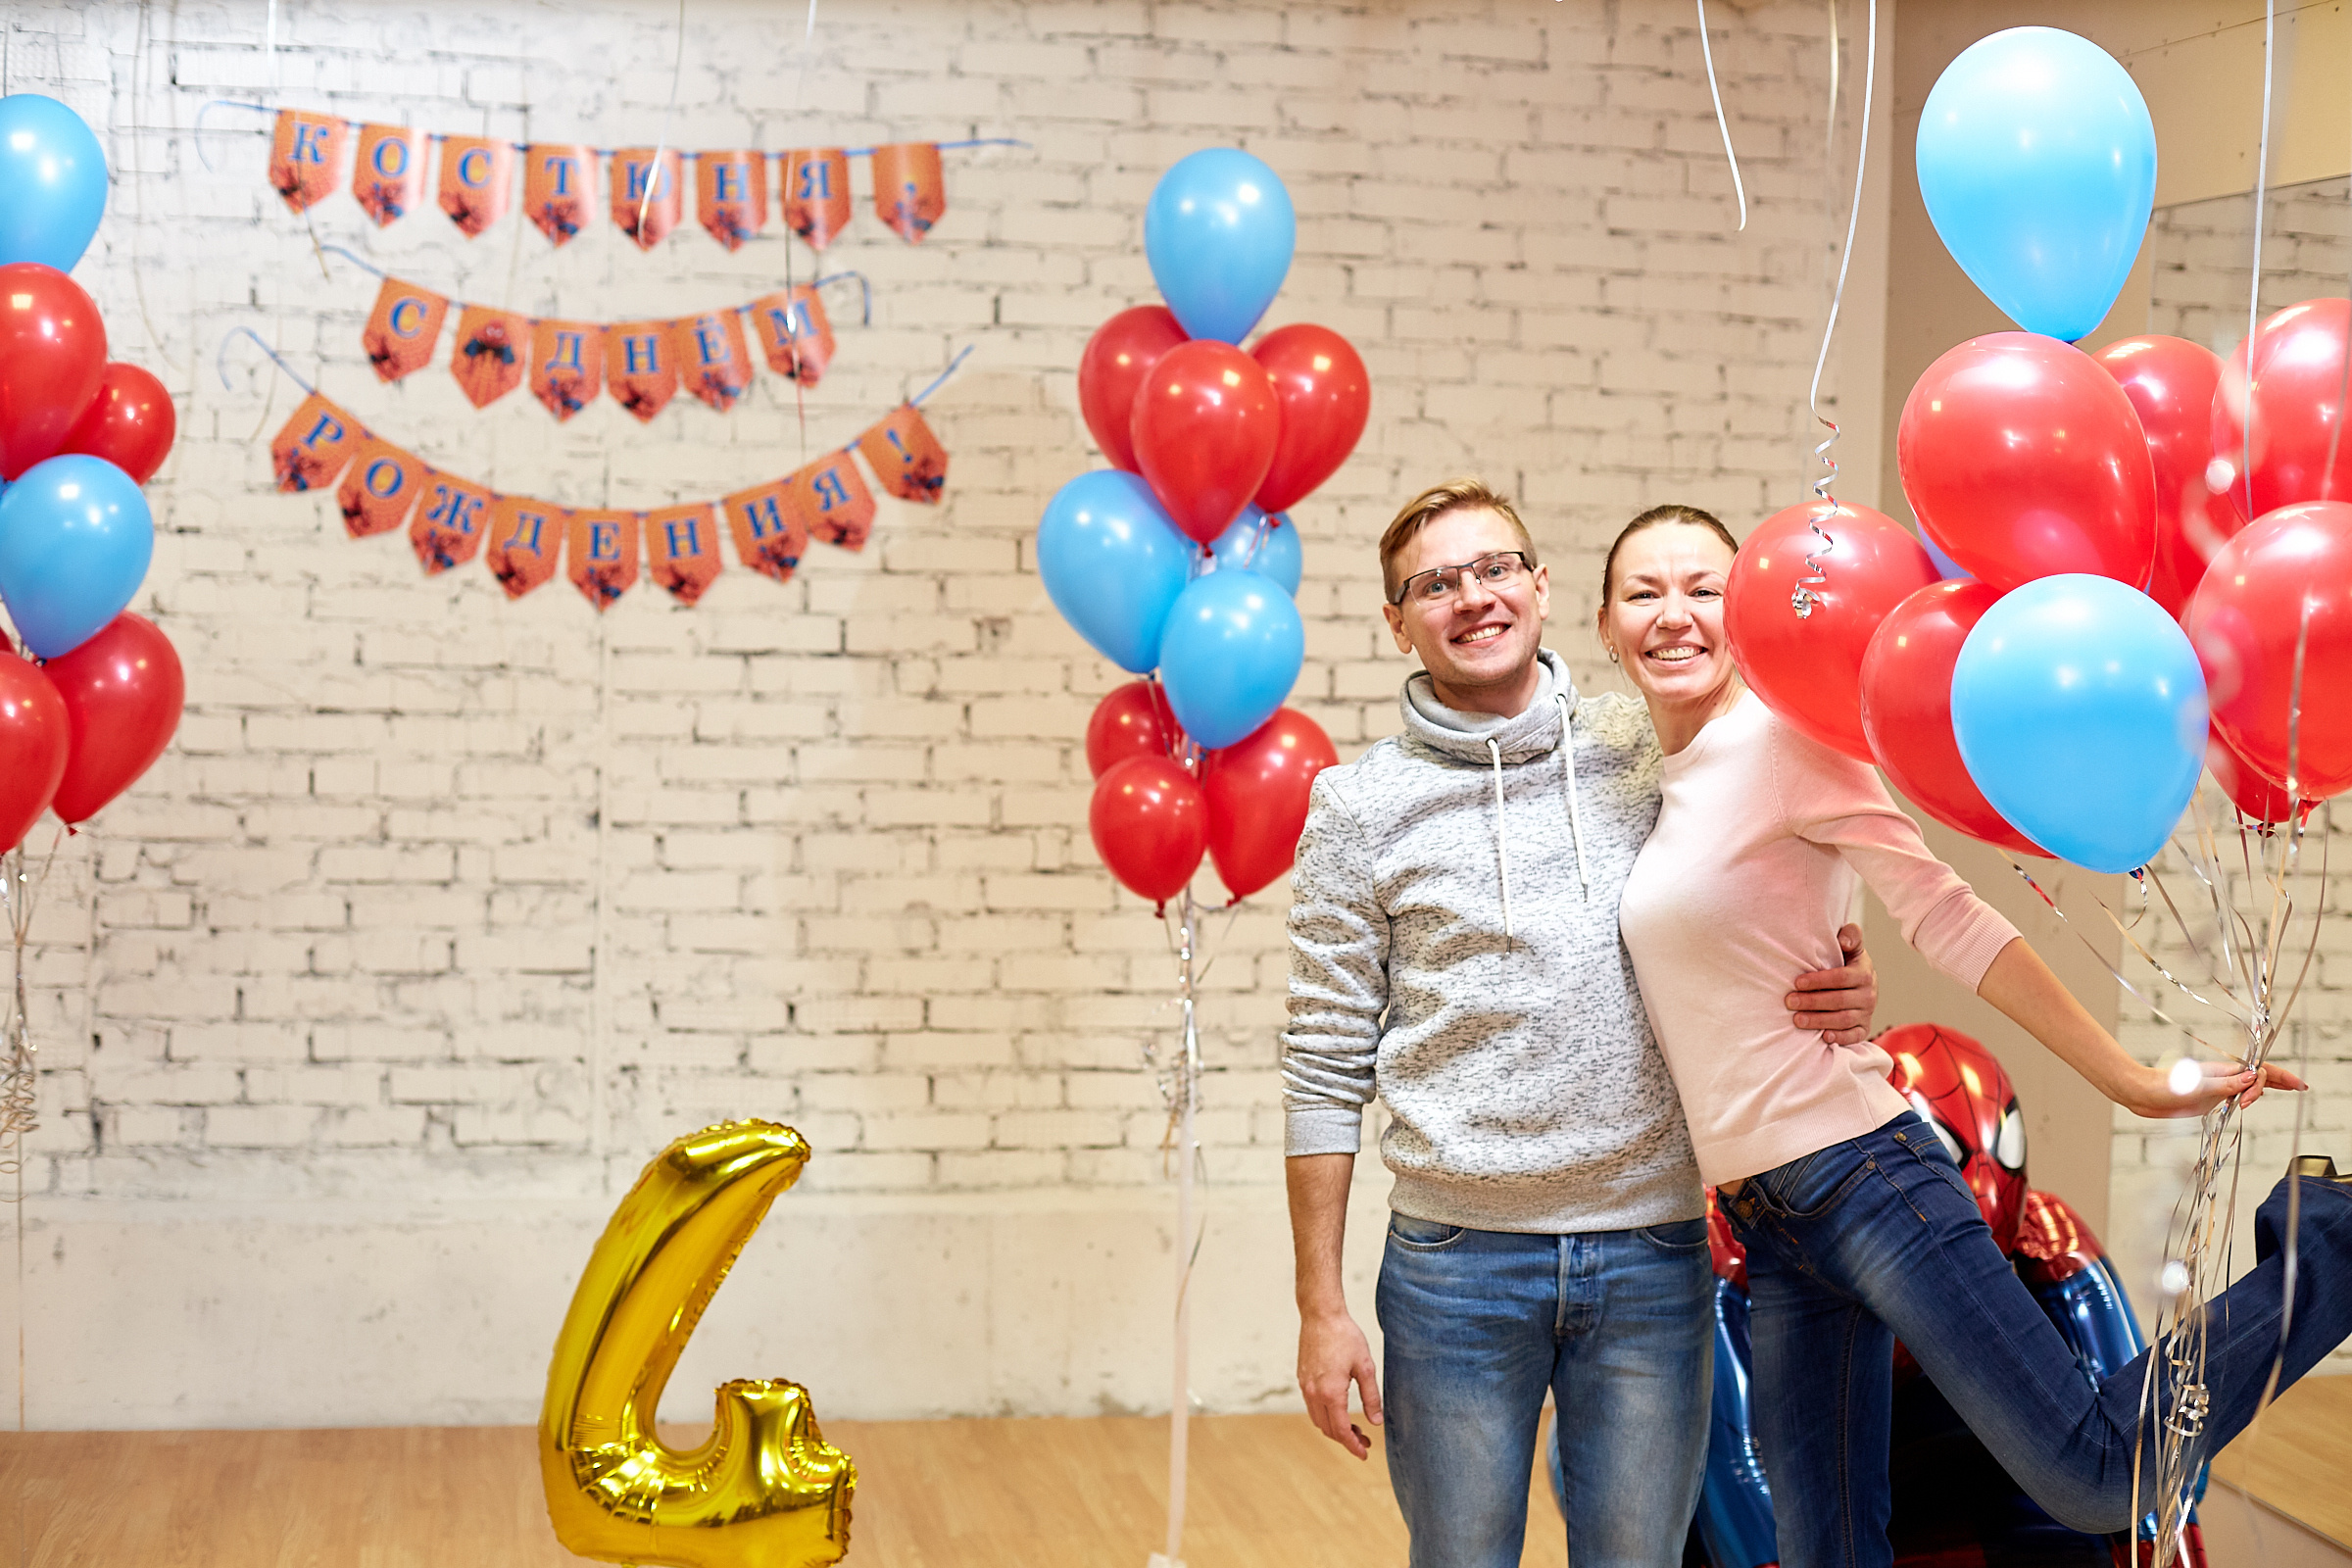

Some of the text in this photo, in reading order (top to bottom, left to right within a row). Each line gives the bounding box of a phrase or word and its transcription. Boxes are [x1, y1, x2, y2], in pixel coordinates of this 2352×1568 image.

[389, 298, 818, 376] С ДНЁМ
[300, 410, 913, 562] РОЖДЕНИЯ!
